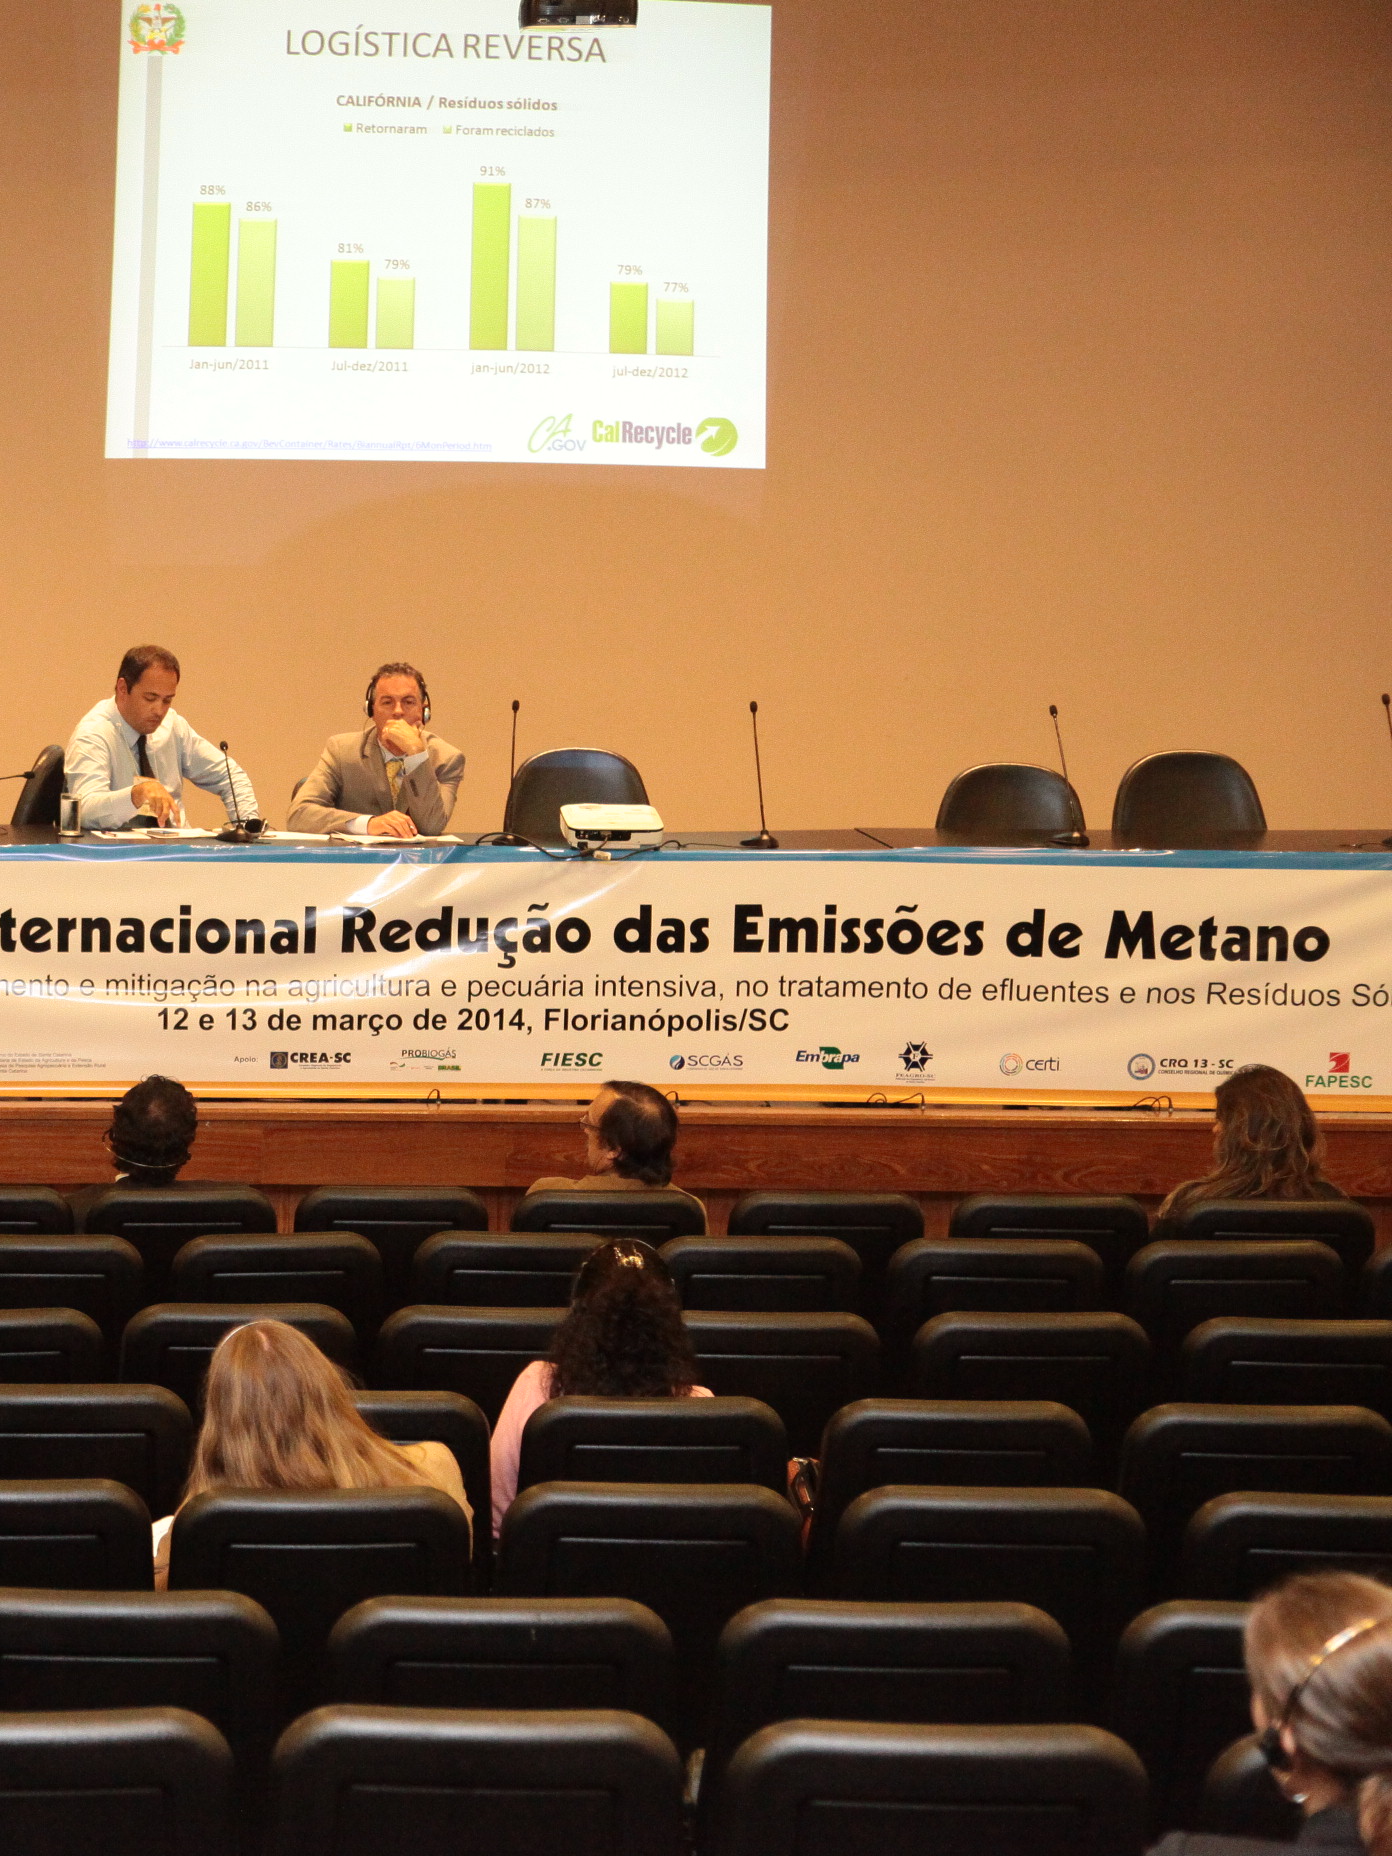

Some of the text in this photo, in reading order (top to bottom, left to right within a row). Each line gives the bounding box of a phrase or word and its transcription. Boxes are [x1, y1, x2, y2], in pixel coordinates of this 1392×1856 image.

[286, 24, 607, 63] LOGÍSTICA REVERSA
[336, 93, 422, 107] CALIFÓRNIA
[439, 97, 504, 109] Resíduos
[506, 98, 558, 111] sólidos
[356, 123, 427, 134] Retornaram
[456, 125, 555, 137] Foram reciclados
[479, 165, 506, 177] 91%
[199, 184, 226, 196] 88%
[245, 200, 272, 213] 86%
[524, 197, 551, 210] 87%
[337, 242, 364, 254] 81%
[384, 258, 410, 270] 79%
[617, 264, 643, 276] 79%
[663, 281, 689, 294] 77%
[592, 420, 692, 449] CalRecycle
[341, 903, 591, 968] Redução
[614, 904, 709, 953] das
[734, 904, 984, 956] Emissões
[1006, 909, 1083, 958] de
[1105, 910, 1330, 962] Metano
[81, 978, 96, 996] e
[106, 973, 235, 1002] mitigação
[246, 979, 277, 996] na
[288, 974, 431, 1003] agricultura
[441, 980, 456, 997] e
[468, 974, 583, 1003] pecuária
[595, 974, 723, 1000] intensiva,
[736, 980, 768, 997] no
[779, 976, 928, 999] tratamento
[938, 977, 971, 1000] de
[982, 978, 1109, 1003] efluentes
[1120, 987, 1136, 1004] e
[1147, 987, 1195, 1004] nos
[1207, 982, 1340, 1007] Resíduos
[1352, 983, 1392, 1007] Só
[158, 1008, 789, 1037] 12 e 13 de março de 2014, Florianópolis/SC
[290, 1052, 351, 1063] CREA-SC
[401, 1047, 457, 1059] PROBIOGÁS
[541, 1052, 603, 1067] FIESC
[688, 1053, 743, 1066] SCGÁS
[796, 1049, 860, 1064] Embrapa
[1160, 1058, 1188, 1068] CRQ
[1194, 1059, 1208, 1068] 13
[1218, 1059, 1234, 1068] SC
[1306, 1075, 1372, 1088] FAPESC
